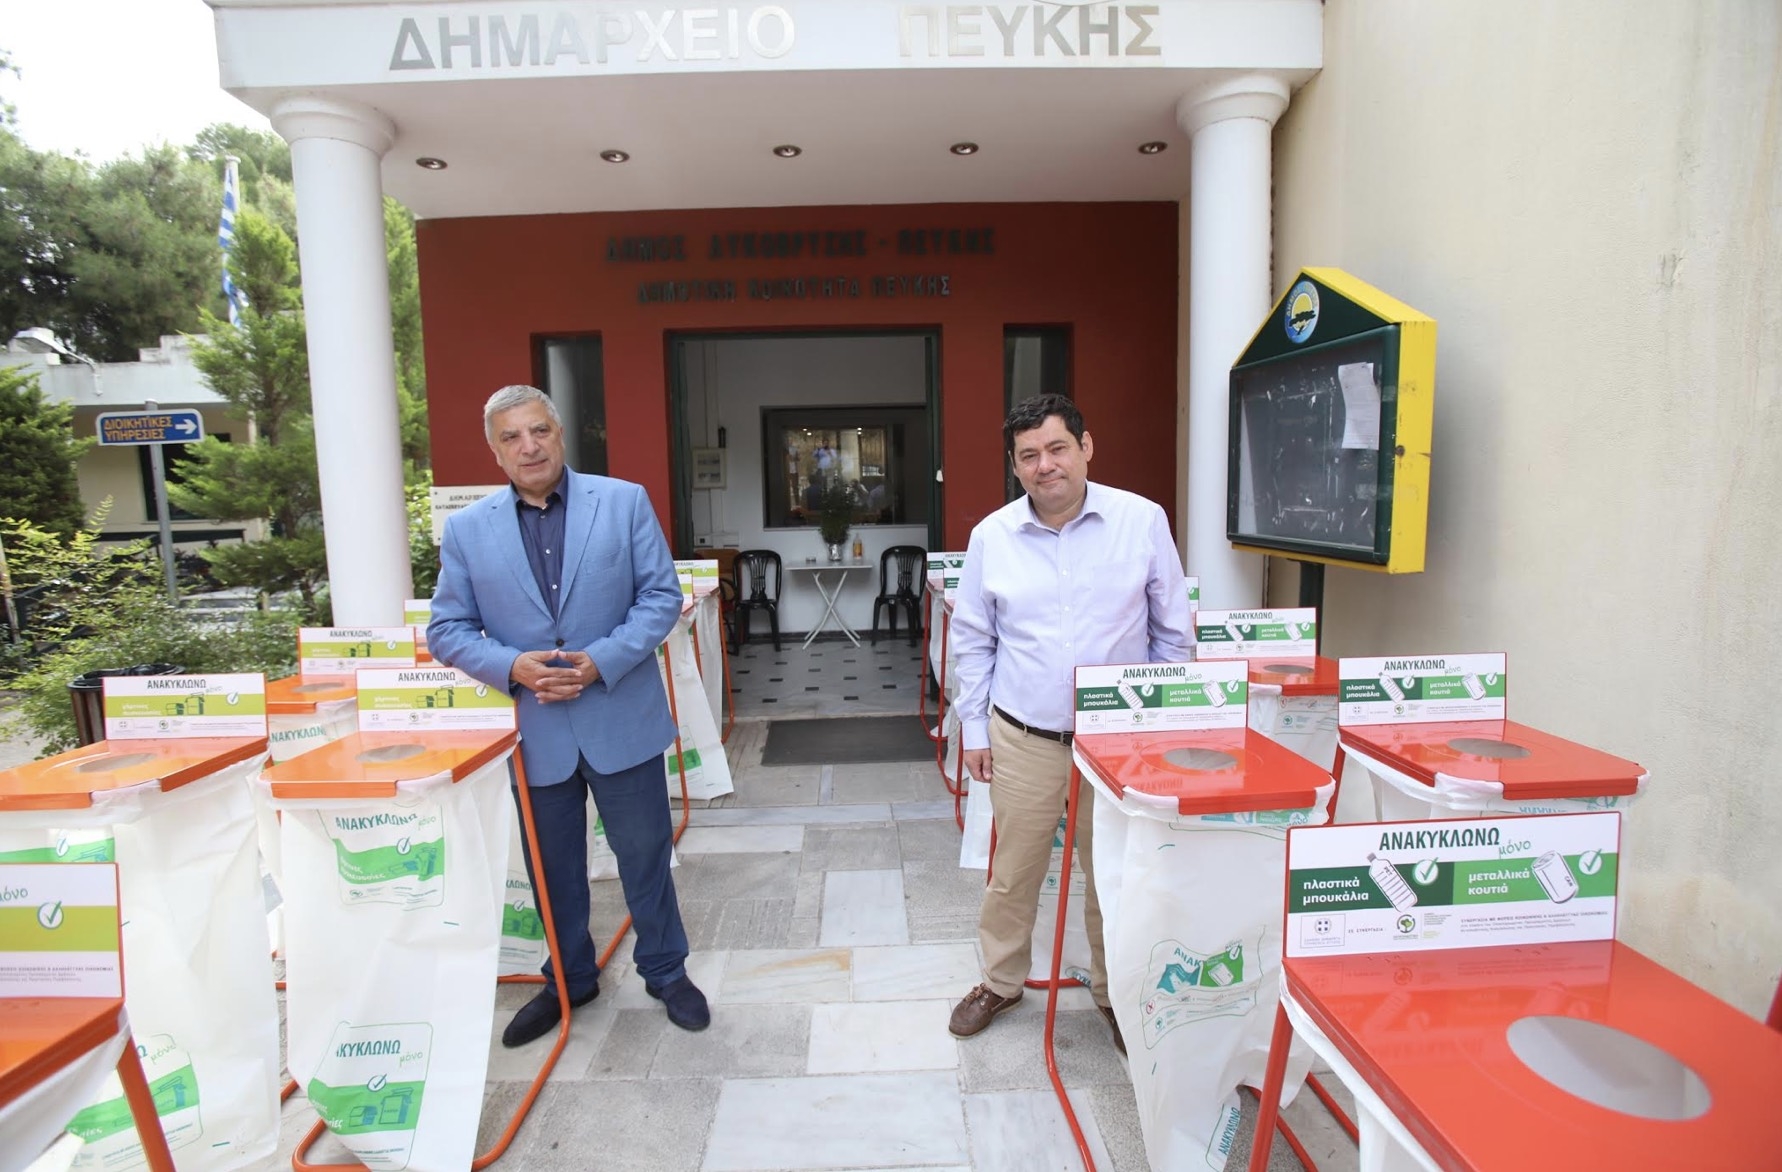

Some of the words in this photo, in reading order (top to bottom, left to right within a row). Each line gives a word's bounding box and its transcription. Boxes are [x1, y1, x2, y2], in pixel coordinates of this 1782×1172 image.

[388, 5, 796, 71] ΔΗΜΑΡΧΕΙΟ
[898, 5, 1161, 57] ΠΕΥΚΗΣ
[104, 416, 172, 430] ΔΙΟΙΚΗΤΙΚΕΣ
[105, 428, 166, 441] ΥΠΗΡΕΣΙΕΣ
[1228, 612, 1273, 620] ΑΝΑΚΥΚΛΩΝΩ
[329, 630, 373, 638] ΑΝΑΚΥΚΛΩΝΩ
[1384, 659, 1446, 671] ΑΝΑΚΥΚΛΩΝΩ
[398, 671, 456, 682] ΑΝΑΚΥΚΛΩΝΩ
[1122, 666, 1186, 679] ΑΝΑΚΥΚΛΩΝΩ
[147, 679, 207, 689] ΑΝΑΚΥΚΛΩΝΩ
[1083, 691, 1114, 699] πλαστικά
[1346, 691, 1380, 699] μπουκάλια
[1083, 699, 1119, 708] μπουκάλια
[1379, 827, 1501, 850] ΑΝΑΚΥΚΛΩΝΩ
[1498, 839, 1532, 860] μόνο
[1468, 867, 1531, 884] μεταλλικά
[1303, 876, 1360, 890] πλαστικά
[1468, 883, 1509, 895] κουτιά
[1303, 890, 1369, 906] μπουκάλια
[399, 1051, 424, 1068] μόνο
